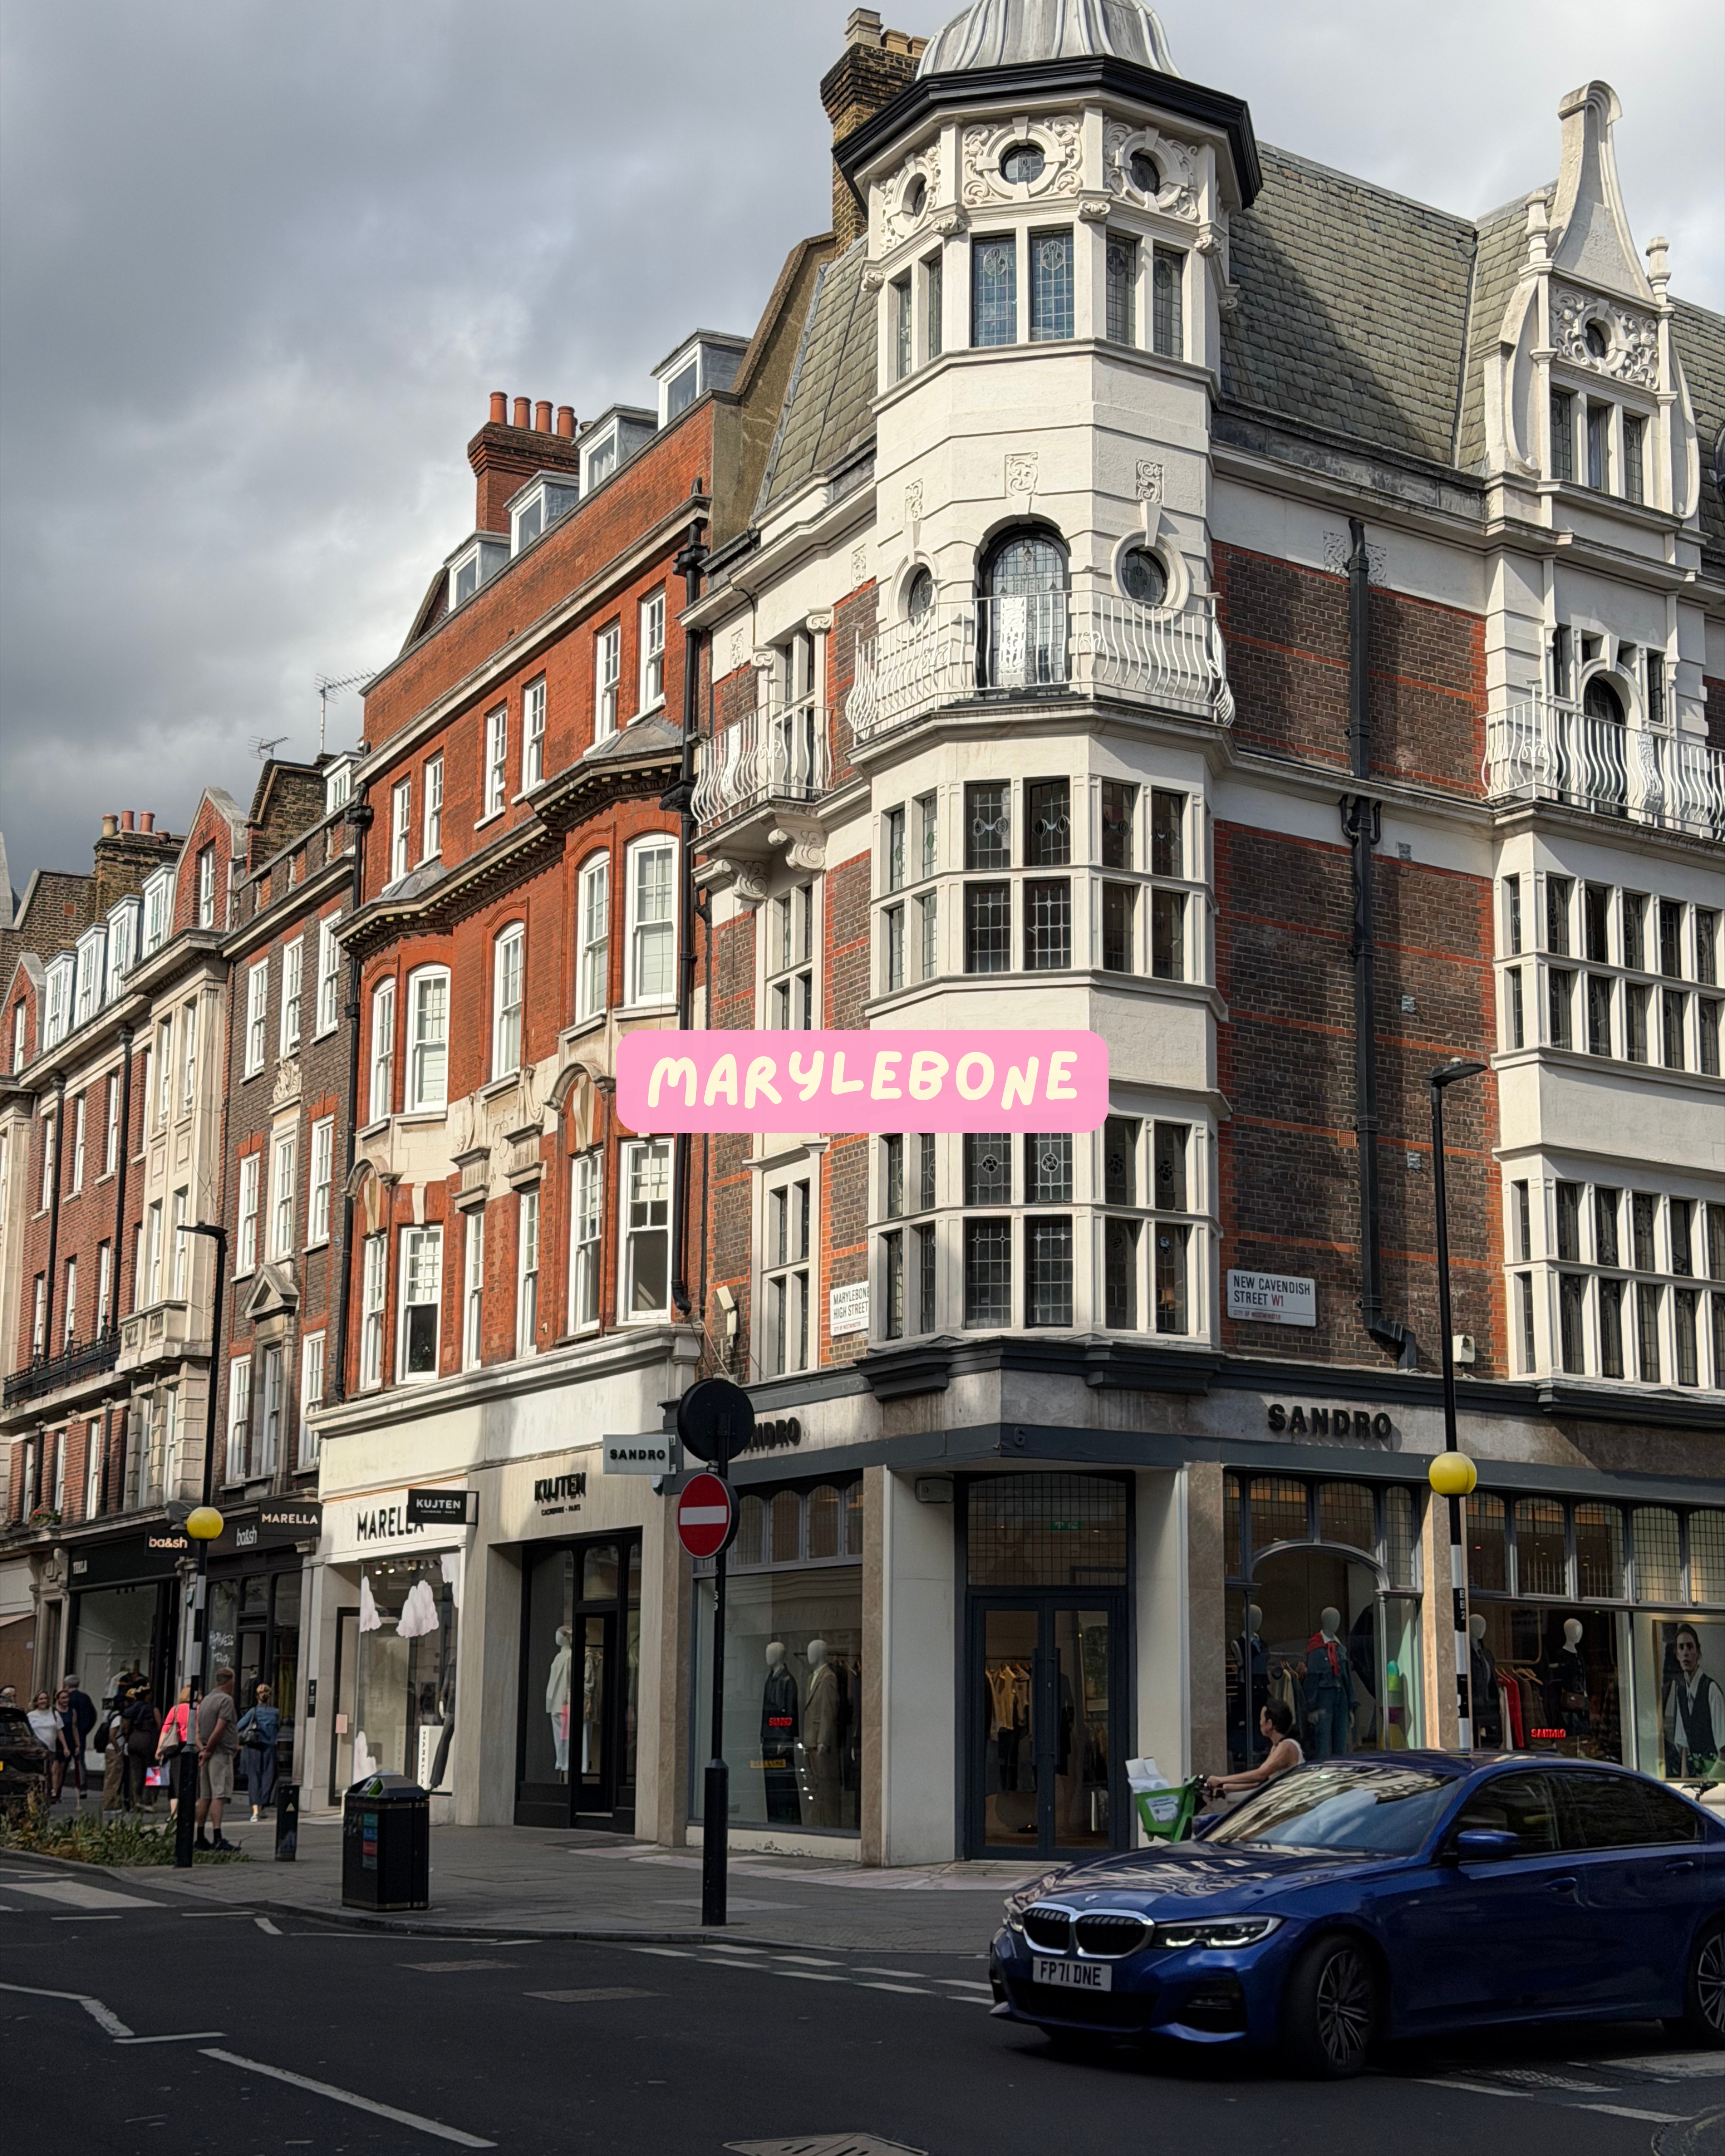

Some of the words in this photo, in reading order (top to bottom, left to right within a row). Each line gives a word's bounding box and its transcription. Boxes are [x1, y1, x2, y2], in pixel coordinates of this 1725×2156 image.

[1233, 1275, 1255, 1289] NEW
[1258, 1278, 1310, 1295] CAVENDISH
[1234, 1290, 1268, 1306] STREET
[1271, 1294, 1284, 1307] W1
[833, 1306, 847, 1319] HIGH
[848, 1301, 869, 1316] STREET
[1268, 1404, 1392, 1439] SANDRO
[744, 1417, 801, 1454] NDRO
[1014, 1426, 1026, 1446] 6
[610, 1449, 665, 1460] SANDRO
[416, 1498, 461, 1509] KUJTEN
[261, 1513, 318, 1525] MARELLA
[148, 1536, 188, 1549] ba&sh
[236, 1525, 258, 1547] ba&sh
[1041, 1961, 1070, 1982] FP71
